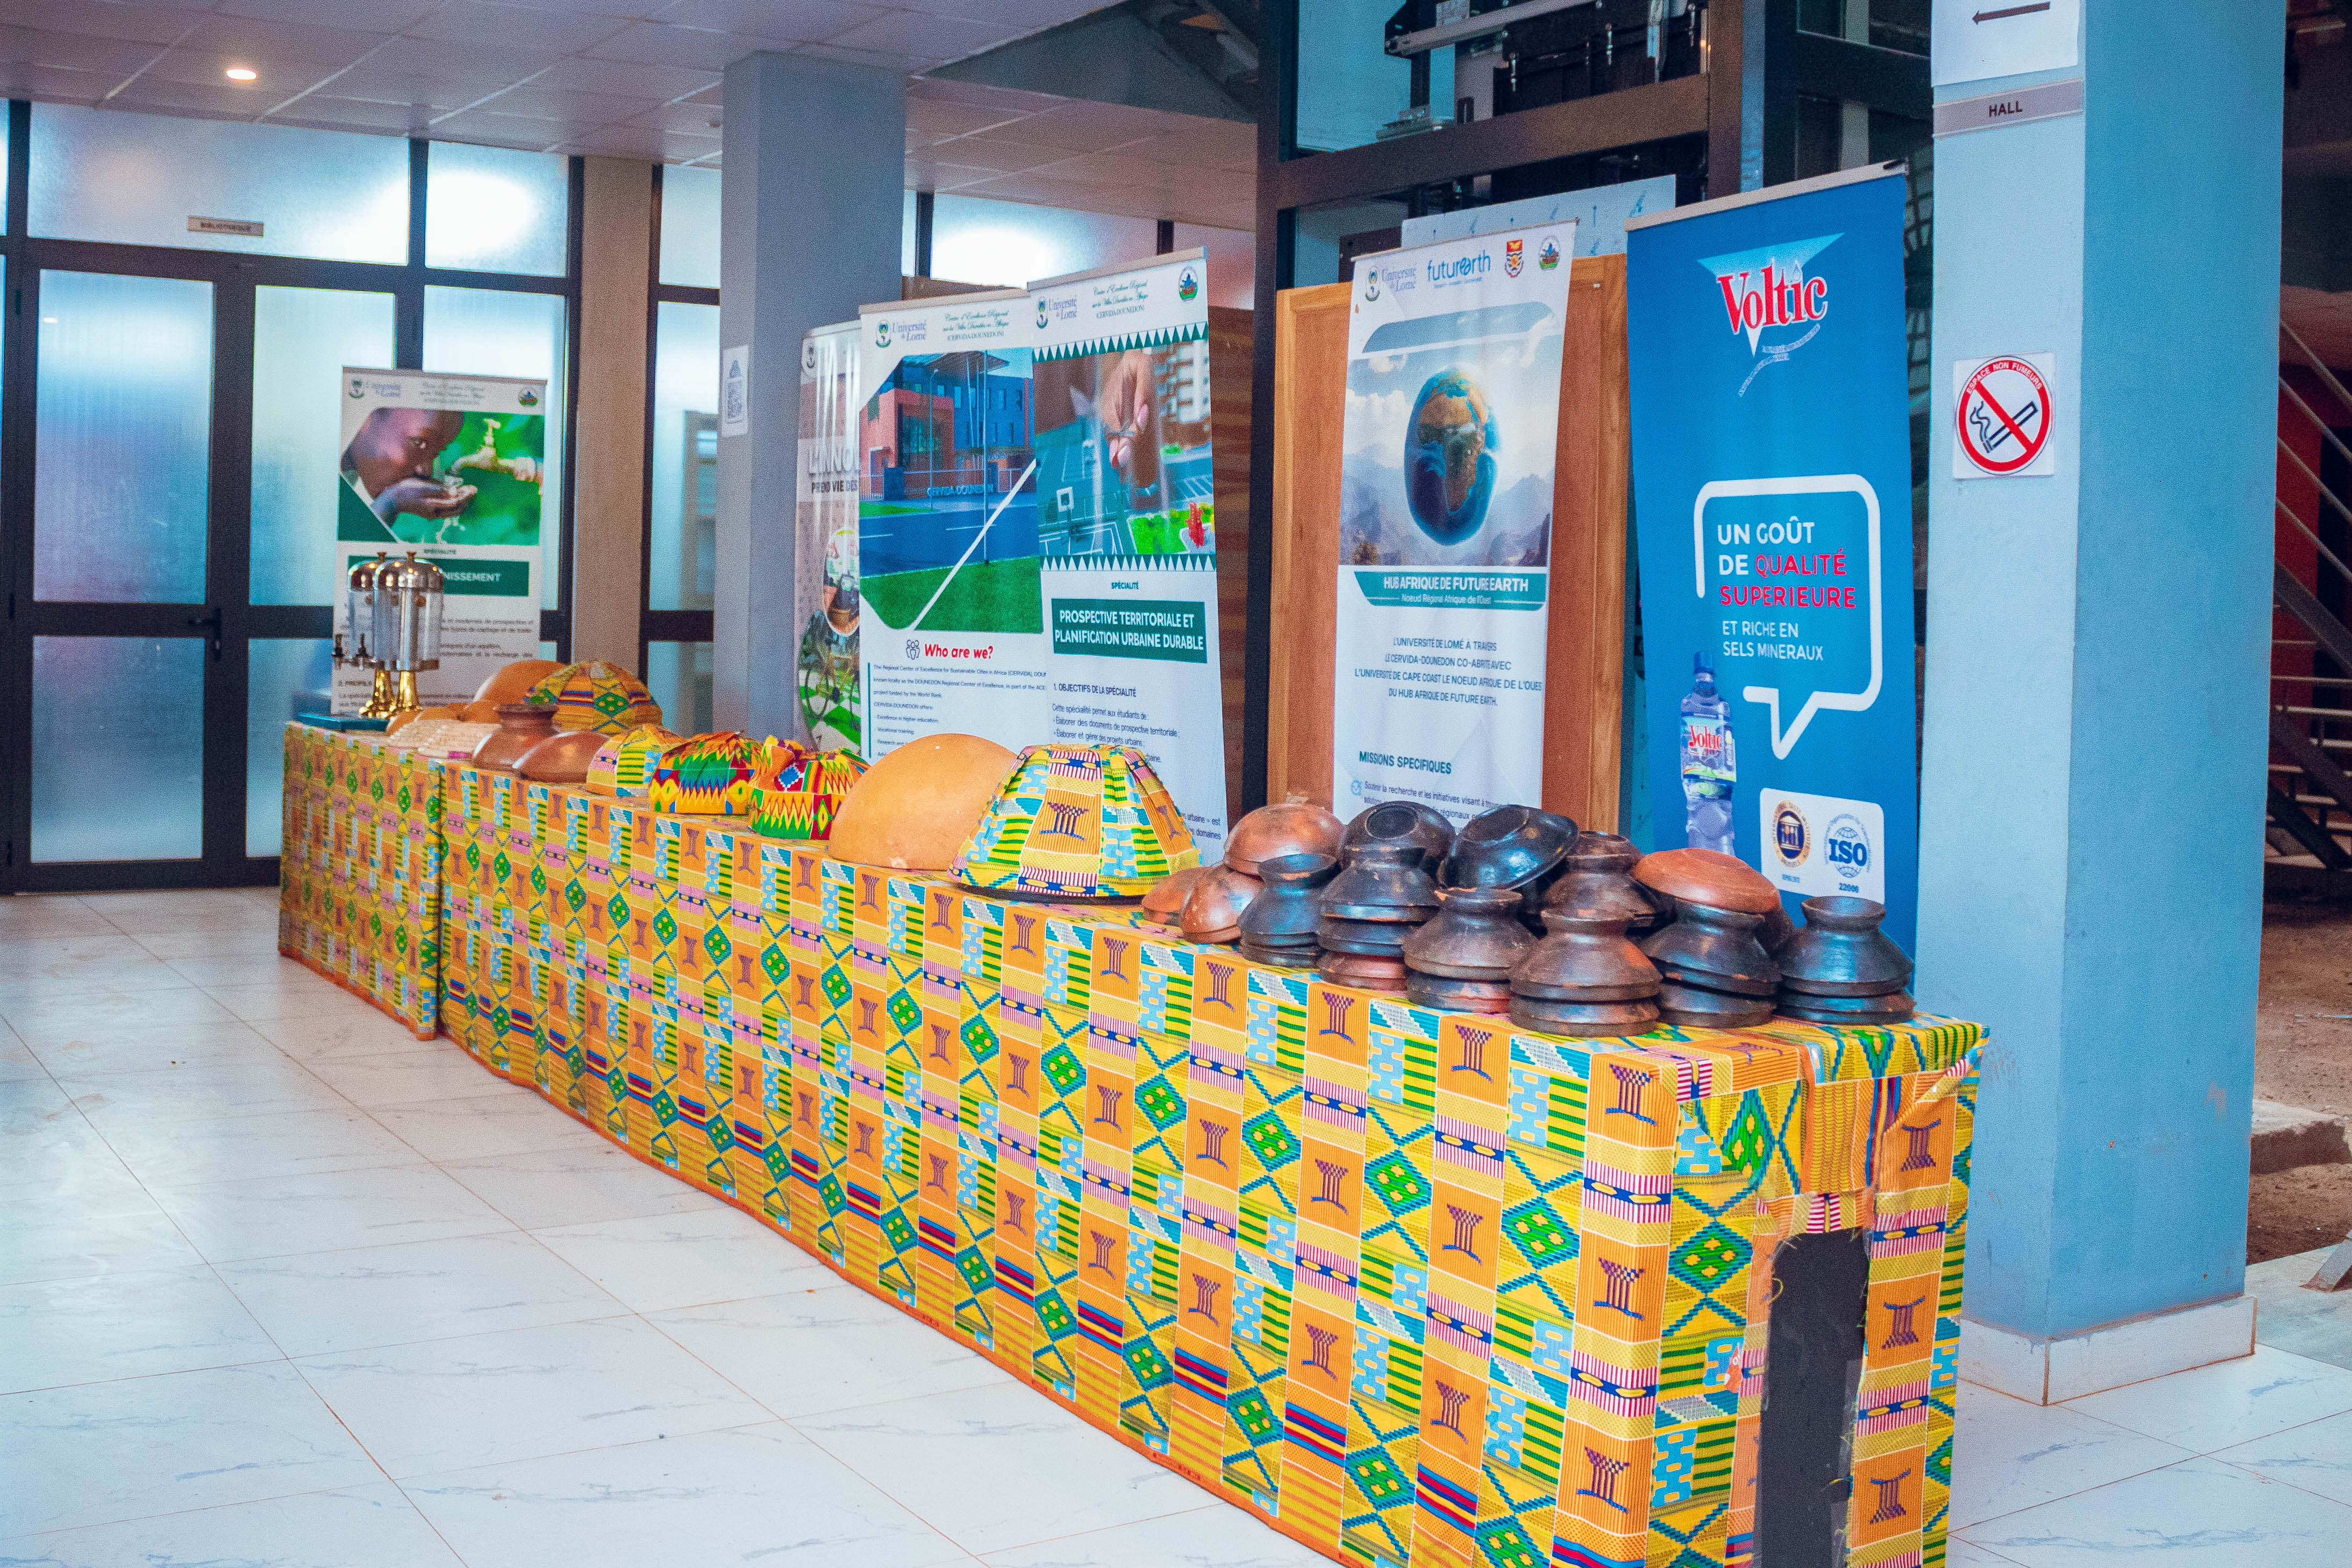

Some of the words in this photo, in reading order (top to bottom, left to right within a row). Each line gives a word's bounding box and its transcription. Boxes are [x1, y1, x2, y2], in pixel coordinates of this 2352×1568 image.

[1988, 100, 2023, 118] HALL
[1717, 261, 1828, 335] Voltic
[1966, 367, 1991, 394] ESPACE
[1993, 361, 2009, 372] NON
[2012, 362, 2041, 389] FUMEURS
[927, 483, 993, 497] CERVIDA-DOUNEDN
[1717, 522, 1750, 545] UN
[1756, 516, 1814, 545] GOÛT
[1718, 554, 1748, 576] DE
[1755, 547, 1846, 578] QUALITÉ
[444, 572, 501, 582] NISSEMENT
[1111, 580, 1139, 590] SPÉCIALITÉ
[1384, 576, 1399, 589] HUB
[1400, 576, 1439, 590] AFRIQUE
[1440, 577, 1451, 590] DE
[1453, 577, 1489, 591] FUTURE
[1490, 577, 1528, 592] EARTH
[1468, 595, 1477, 604] de
[1720, 585, 1856, 608] SUPERIEURE
[1059, 610, 1118, 625] PROSPECTIVE
[1119, 611, 1181, 628] TERRITORIALE
[1183, 614, 1194, 628] ET
[1722, 620, 1738, 635] ET
[1742, 621, 1776, 637] RICHE
[1779, 622, 1798, 637] EN
[1055, 630, 1119, 645] PLANIFICATION
[1121, 631, 1161, 648] URBAINE
[1163, 635, 1204, 650] DURABLE
[1393, 637, 1435, 648] L'UNIVERSITÉ
[1436, 639, 1444, 648] DE
[1444, 638, 1464, 649] LOMÉ
[925, 643, 948, 659] Who
[952, 647, 970, 659] are
[974, 645, 994, 660] we?
[1723, 641, 1754, 657] SELS
[1757, 643, 1824, 661] MINERAUX
[1391, 653, 1455, 666] CERVIDA-DOUNEDON
[1491, 660, 1512, 670] AVEC
[1393, 671, 1401, 680] DE
[1403, 672, 1421, 681] CAPE
[1422, 673, 1441, 683] COAST
[1442, 674, 1450, 684] LE
[1451, 676, 1477, 686] NOEUD
[1504, 679, 1516, 689] DE
[1059, 683, 1091, 693] OBJECTIFS
[1092, 685, 1099, 693] DE
[1099, 686, 1105, 694] LA
[1106, 685, 1137, 697] SPÉCIALITÉ
[1389, 688, 1397, 697] DU
[1398, 689, 1413, 698] HUB
[1415, 690, 1439, 701] AFRIQUE
[1440, 692, 1449, 701] DE
[1450, 693, 1479, 704] FUTURE
[1052, 703, 1065, 712] Cette
[1065, 705, 1091, 714] spécialité
[1117, 709, 1140, 720] étudiants
[1089, 720, 1113, 730] documents
[1121, 724, 1149, 735] prospective
[1078, 731, 1084, 739] et
[1085, 732, 1098, 742] gérer
[1107, 735, 1124, 745] projets
[1146, 753, 1162, 763] baine.
[1359, 751, 1395, 767] MISSIONS
[1397, 756, 1452, 774] SPECIFIQUES
[1382, 784, 1387, 793] la
[1389, 786, 1417, 797] recherche
[1433, 793, 1460, 803] initiatives
[1462, 796, 1480, 805] visant
[1187, 812, 1205, 823] urbaine
[1211, 818, 1221, 826] est
[1196, 828, 1221, 840] domaines
[1828, 838, 1867, 867] ISO
